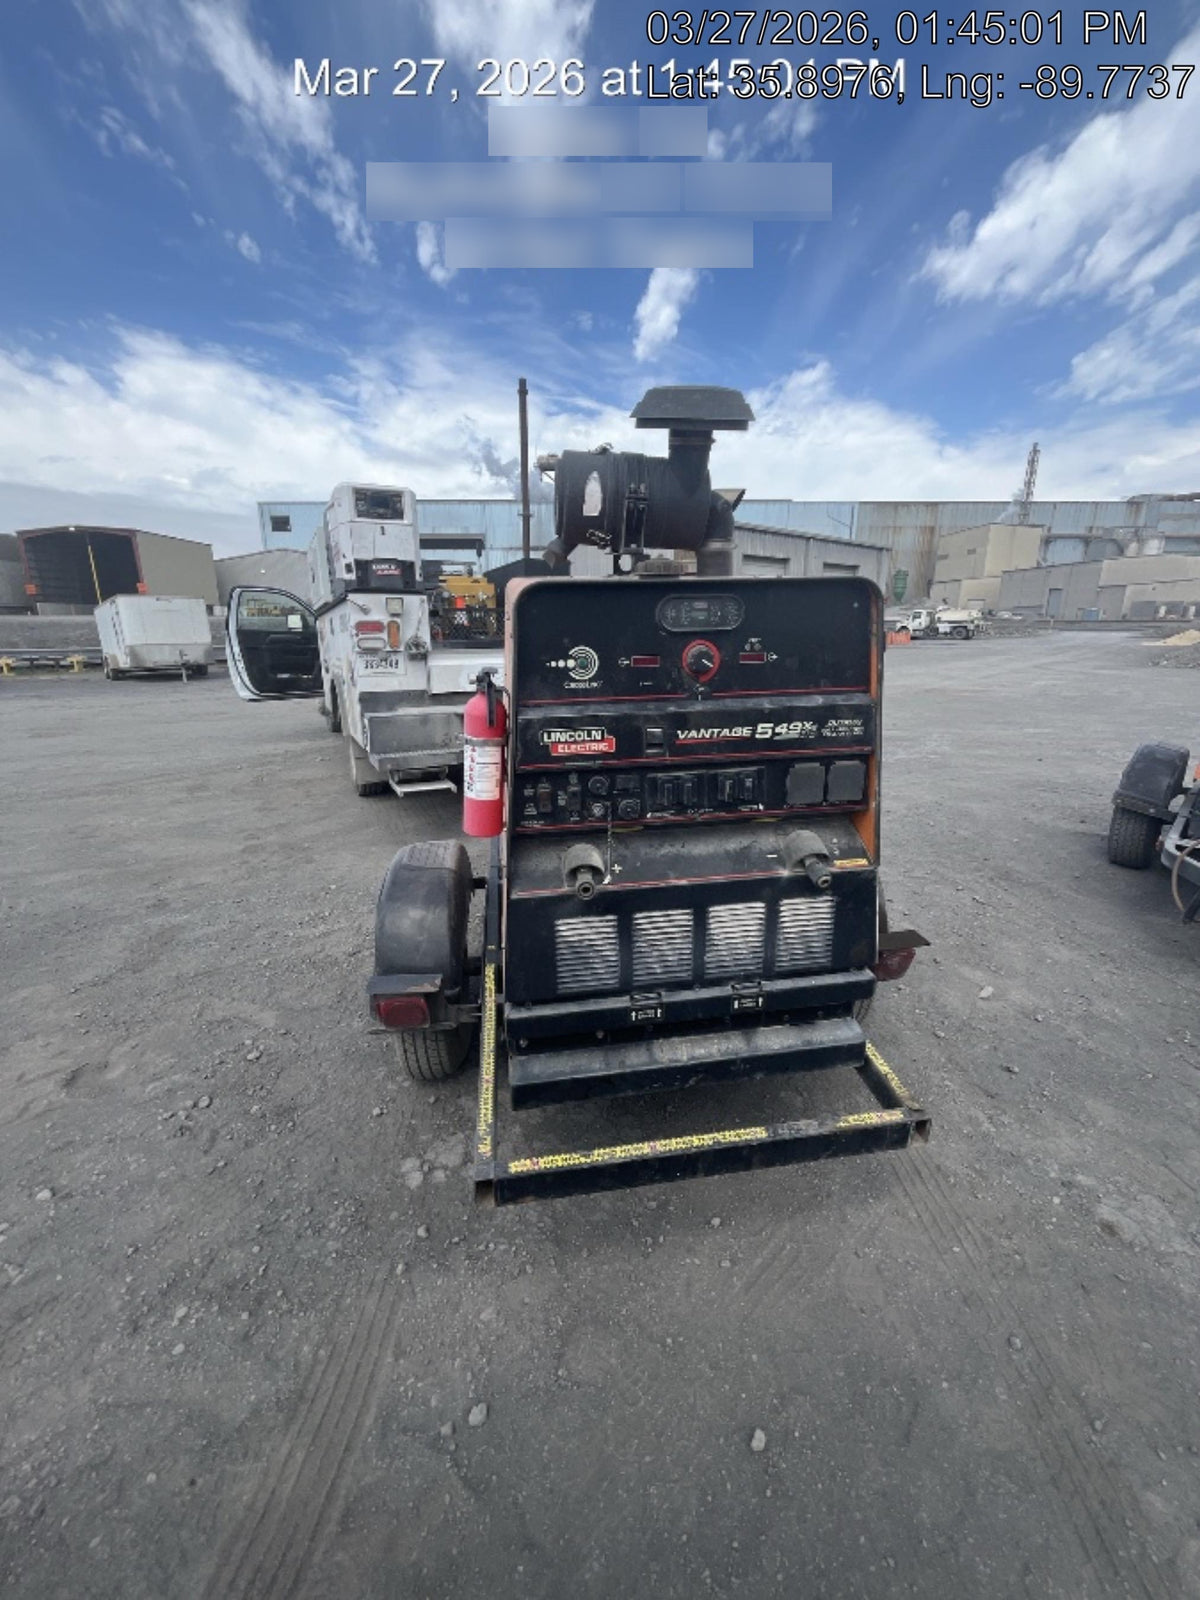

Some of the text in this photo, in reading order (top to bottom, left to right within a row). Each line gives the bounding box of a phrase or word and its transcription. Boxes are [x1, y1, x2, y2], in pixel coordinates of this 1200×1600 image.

[543, 730, 602, 742] LINCOLN
[677, 727, 753, 739] VANTAGE
[557, 742, 609, 753] ELECTRIC
